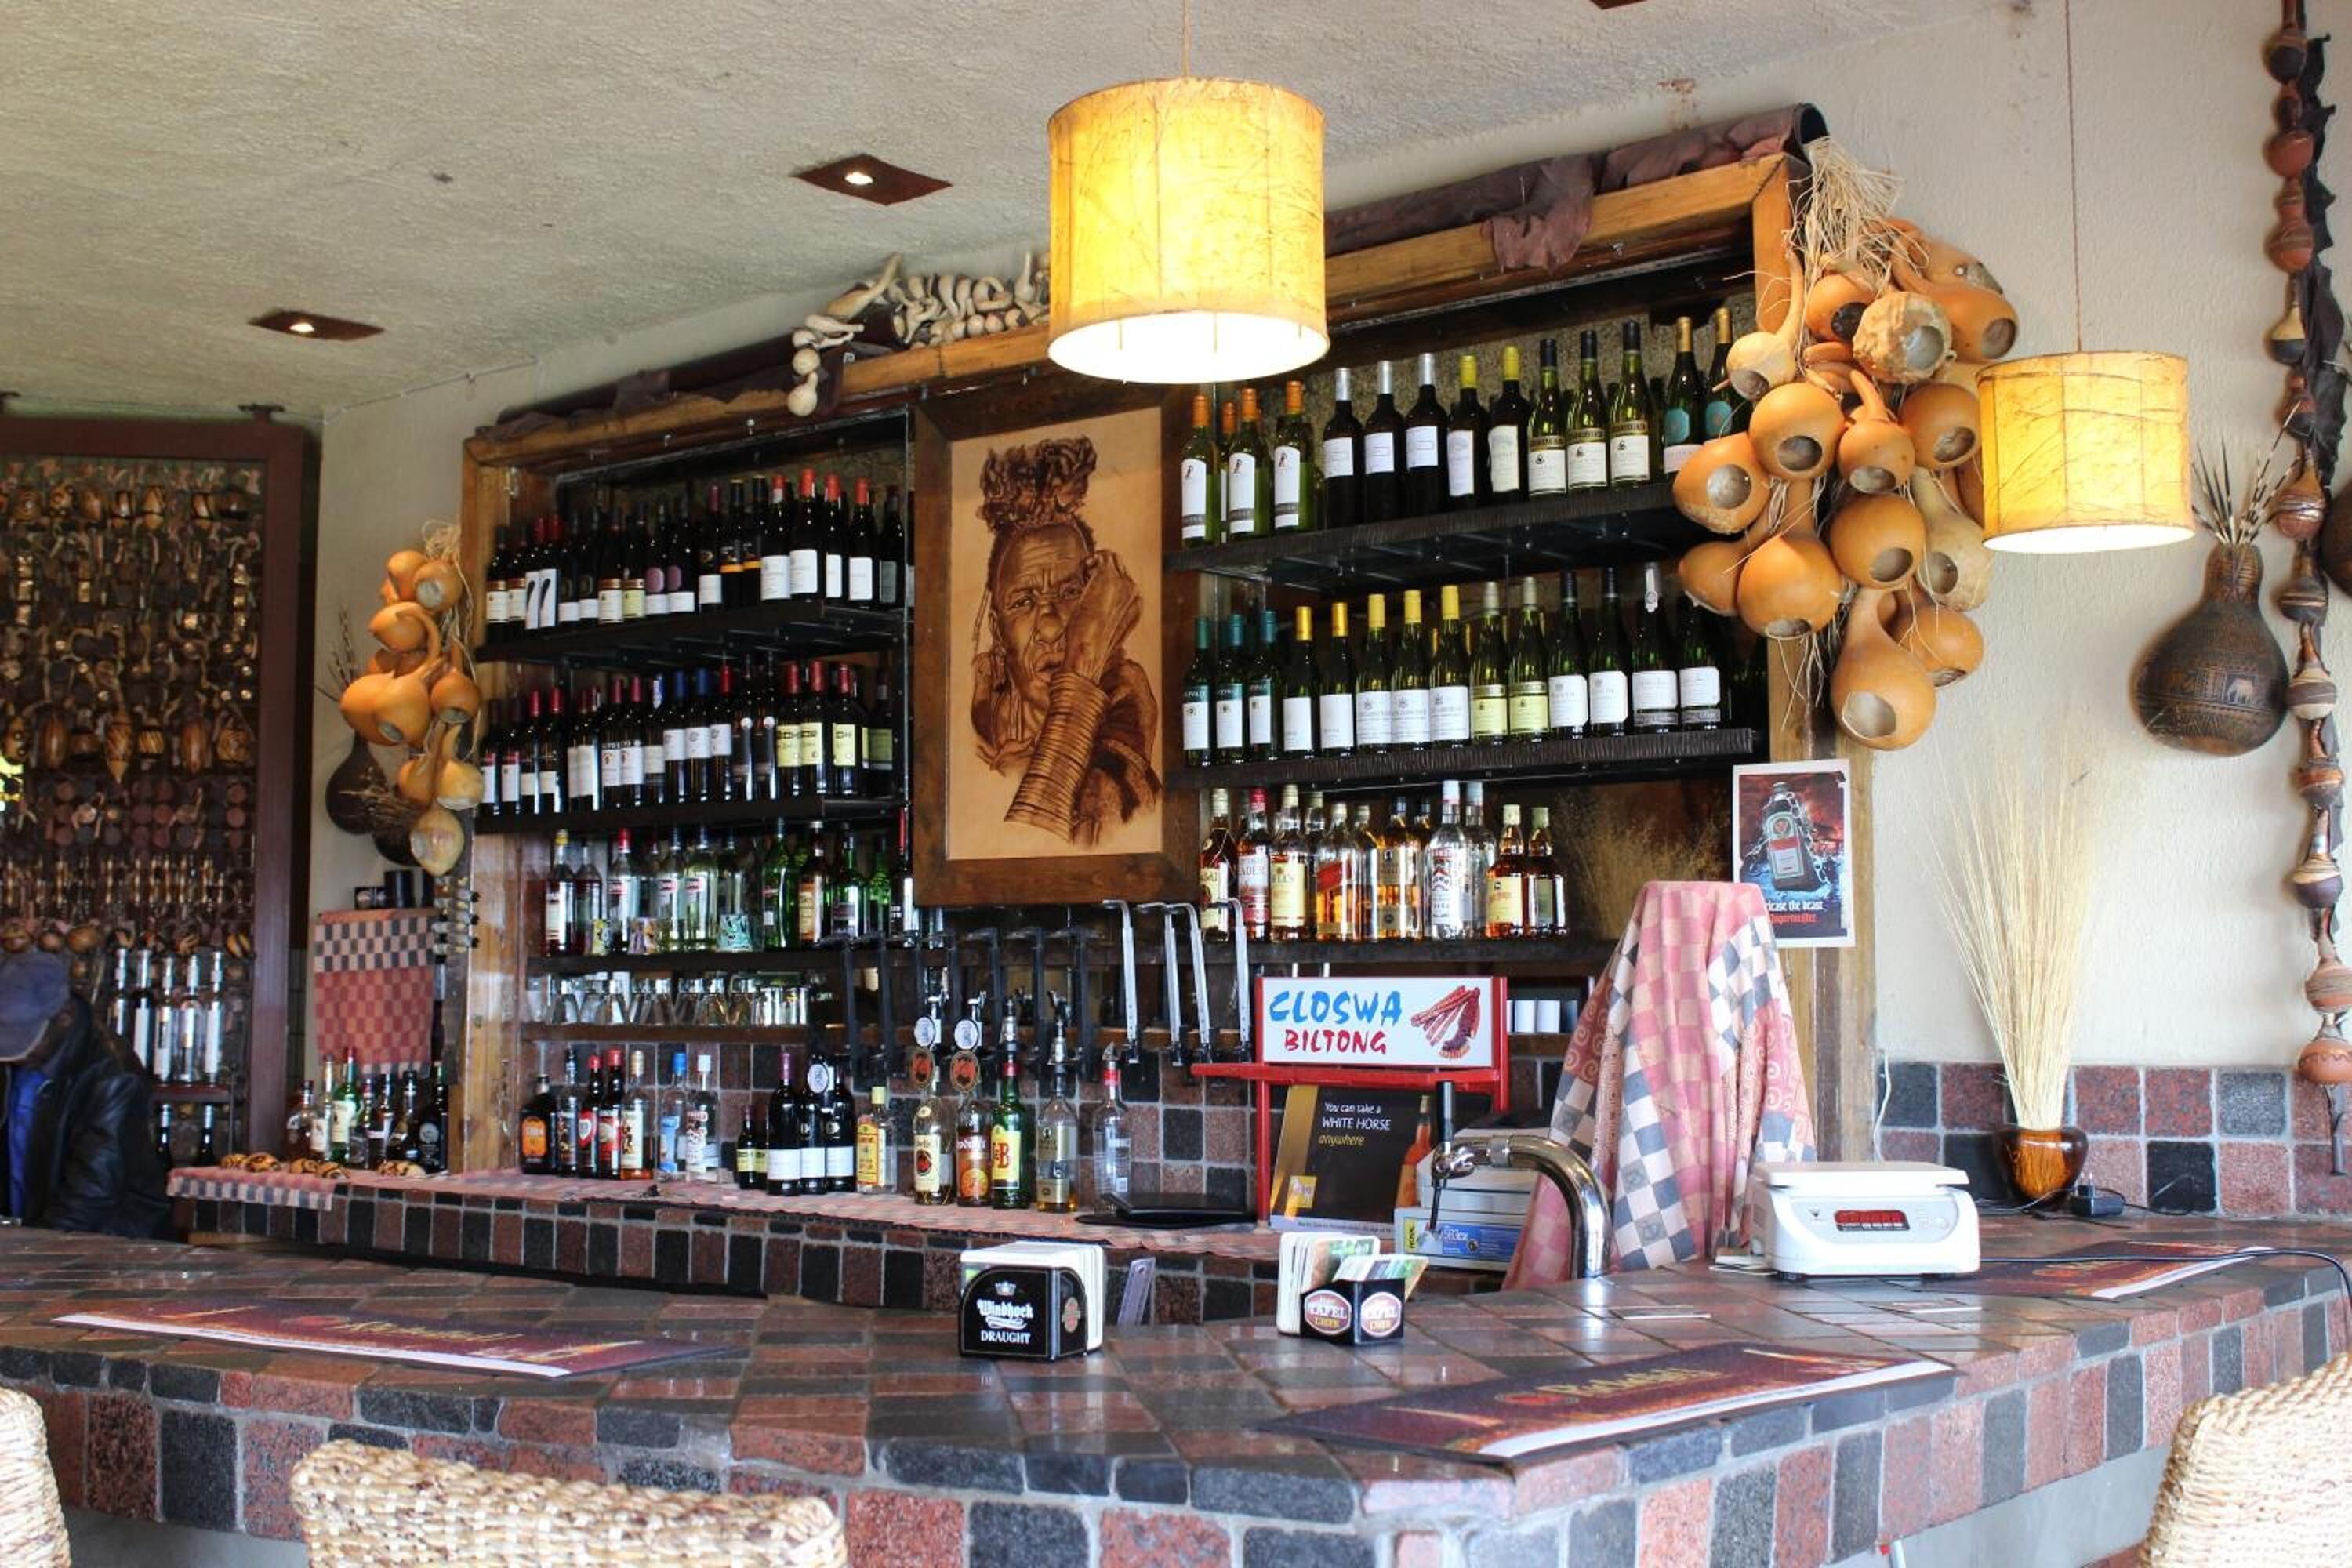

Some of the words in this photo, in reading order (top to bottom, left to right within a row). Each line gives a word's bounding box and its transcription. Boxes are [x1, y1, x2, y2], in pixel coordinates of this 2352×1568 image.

[1284, 1029, 1387, 1054] BILTONG
[1325, 1101, 1338, 1112] You
[1340, 1104, 1356, 1112] can
[1357, 1103, 1374, 1114] take
[1323, 1116, 1354, 1129] WHITE
[1356, 1117, 1392, 1131] HORSE
[1318, 1134, 1366, 1147] anywhere
[977, 1298, 1033, 1319] Windhoek
[981, 1330, 1031, 1344] DRAUGHT
